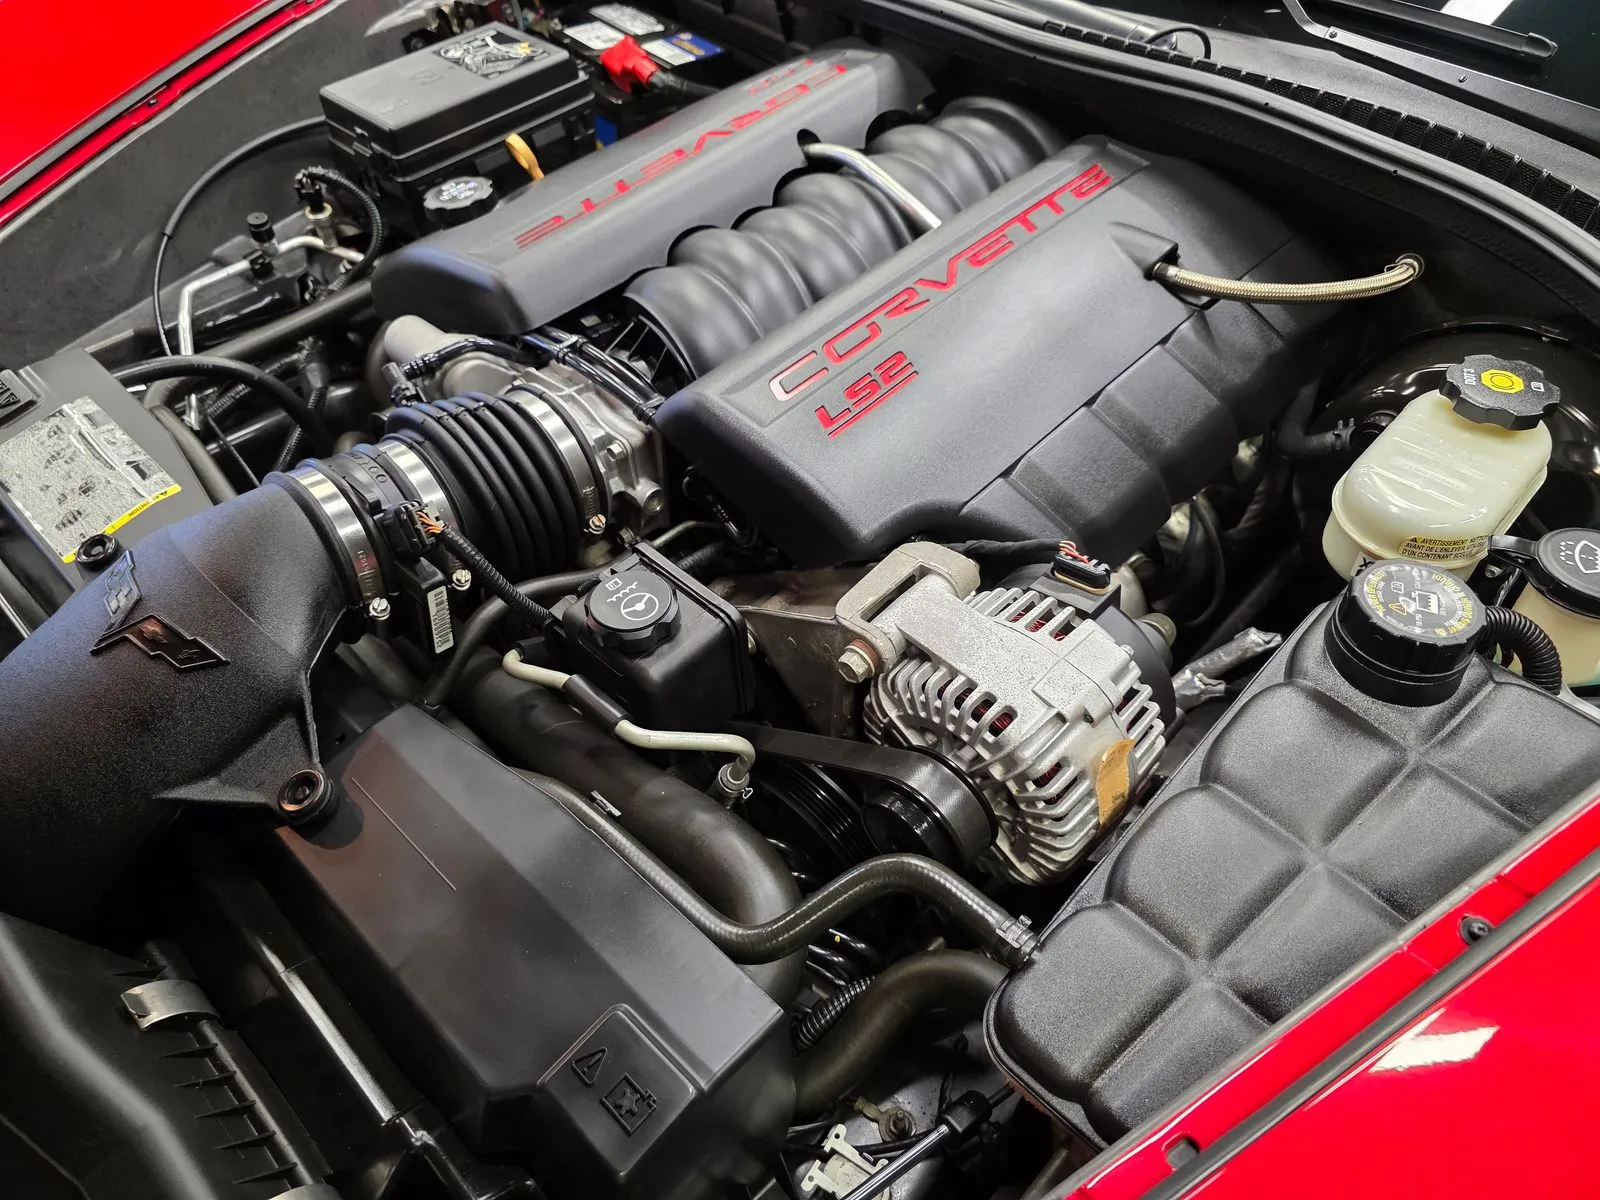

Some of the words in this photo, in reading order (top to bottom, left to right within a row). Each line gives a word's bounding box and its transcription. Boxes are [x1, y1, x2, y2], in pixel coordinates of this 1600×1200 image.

[768, 162, 1114, 402] CORVETTE
[815, 350, 914, 431] LS2
[1401, 548, 1417, 556] D'UN
[1417, 551, 1453, 560] CONTENANT
[1405, 542, 1425, 551] AVANT
